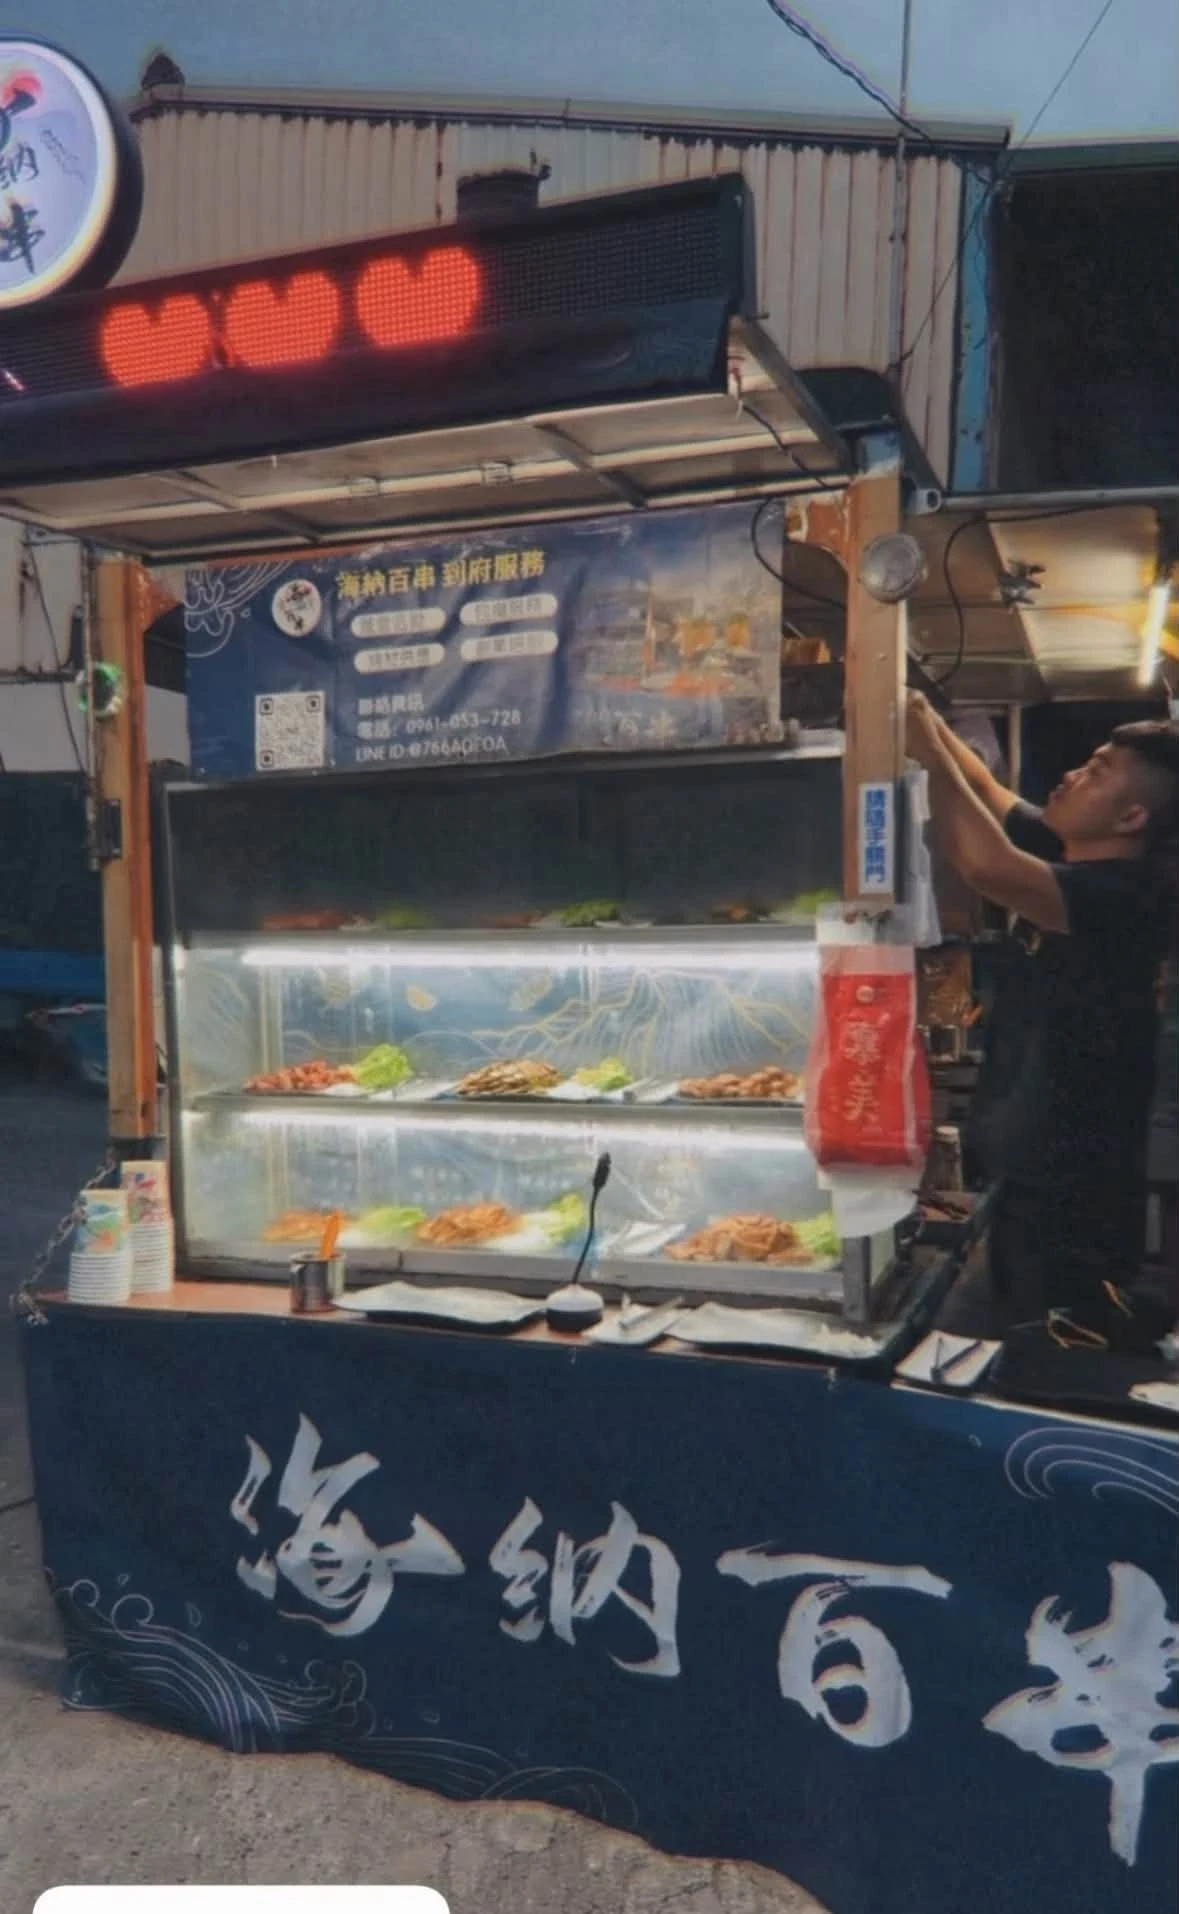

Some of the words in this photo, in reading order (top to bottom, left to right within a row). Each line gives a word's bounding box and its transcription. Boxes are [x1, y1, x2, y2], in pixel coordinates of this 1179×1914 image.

[337, 563, 436, 601] 海納百串
[441, 548, 545, 588] 到府服務
[355, 744, 386, 762] LINE
